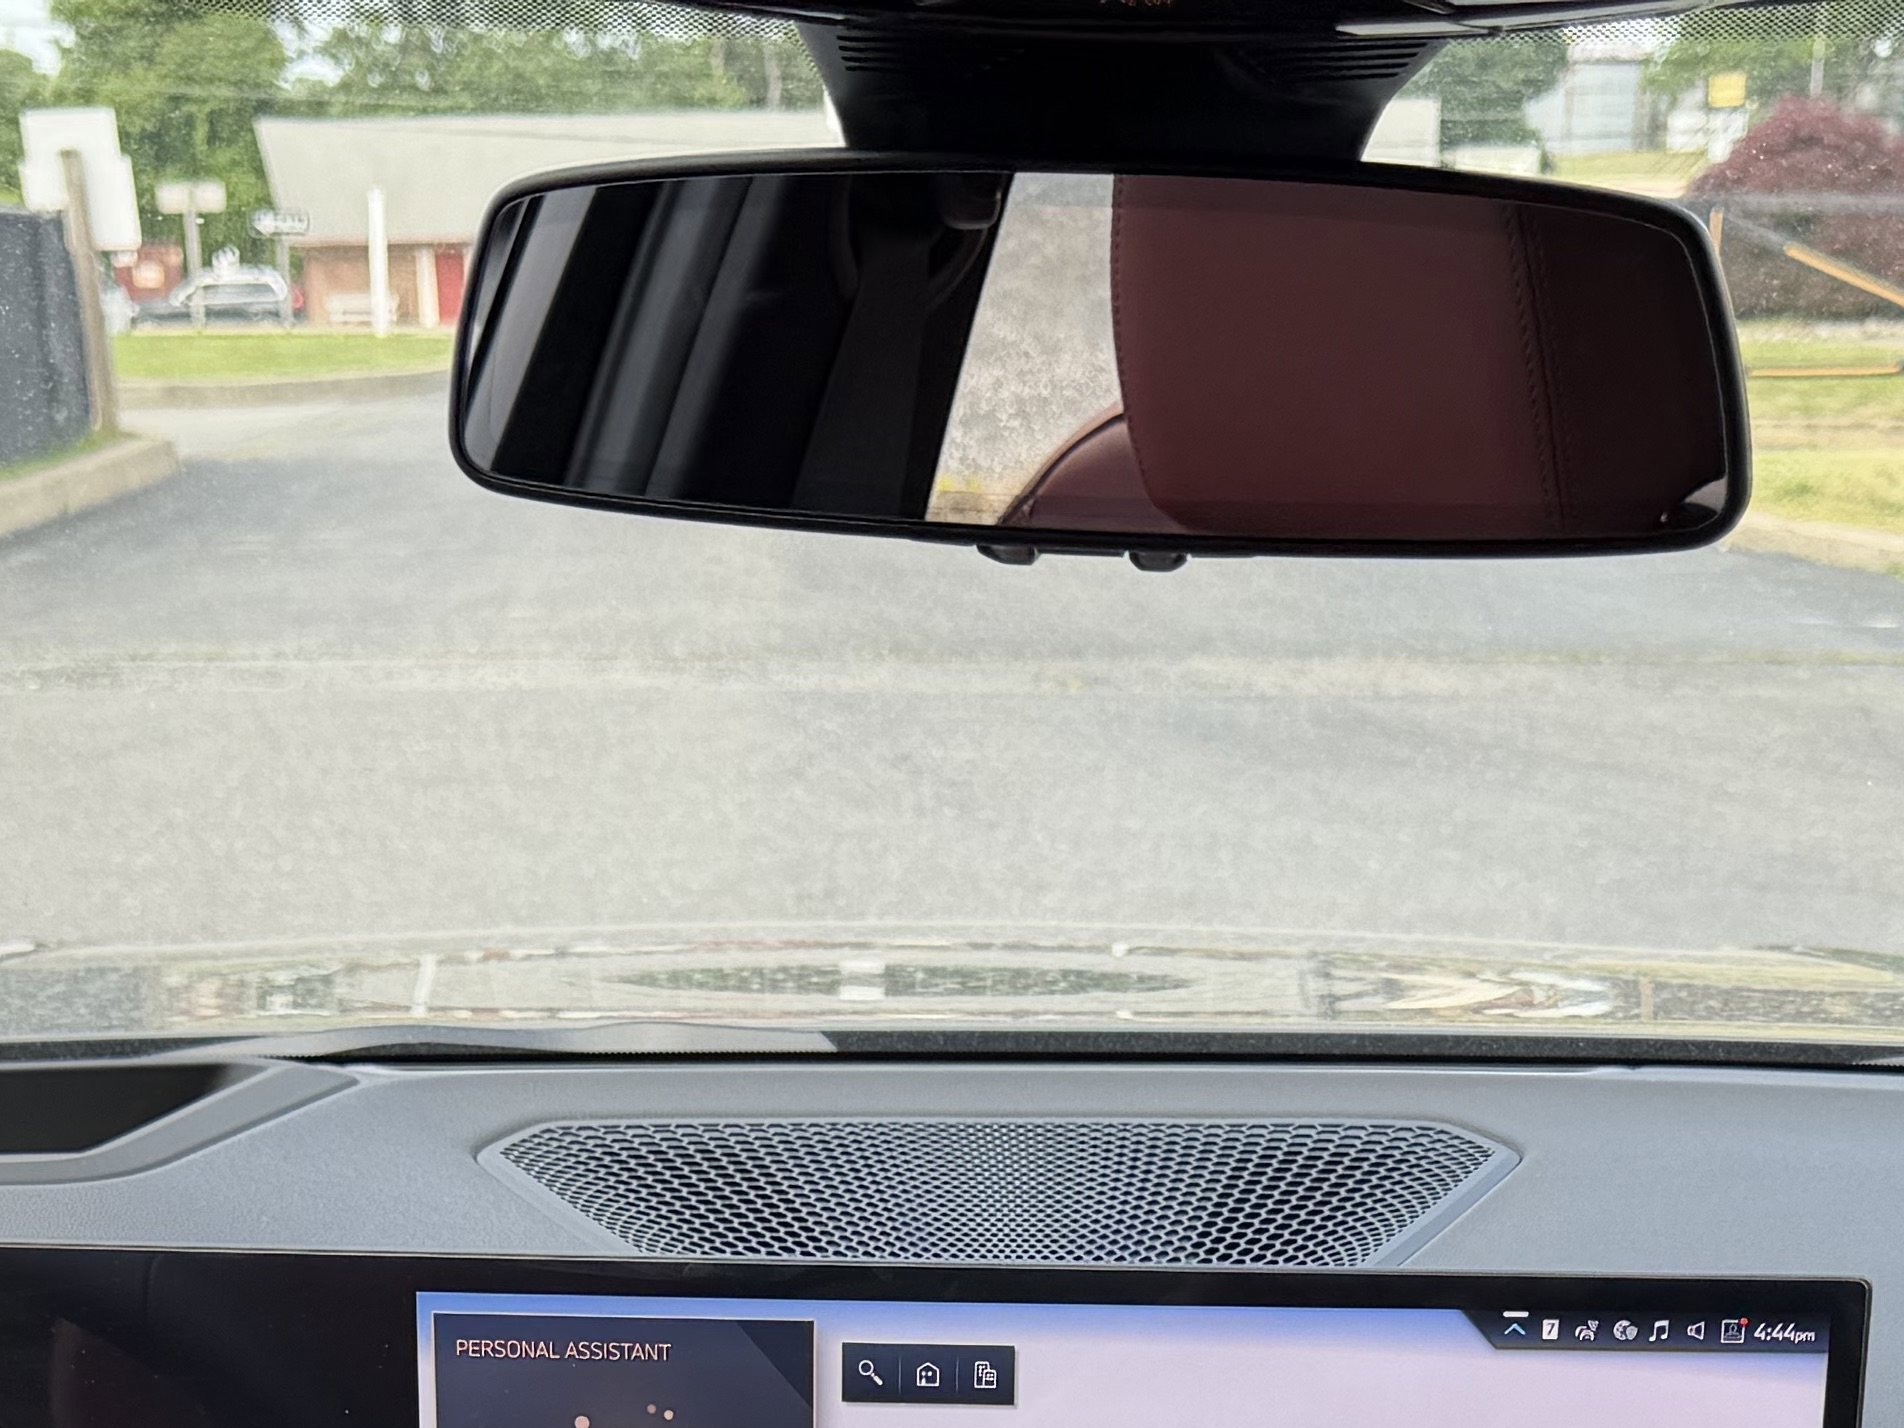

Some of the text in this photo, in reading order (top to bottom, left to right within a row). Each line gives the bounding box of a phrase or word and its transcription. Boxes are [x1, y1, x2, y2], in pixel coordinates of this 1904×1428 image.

[1753, 1322, 1816, 1343] 4:44pm
[455, 1339, 672, 1361] PERSONAL ASSISTANT
